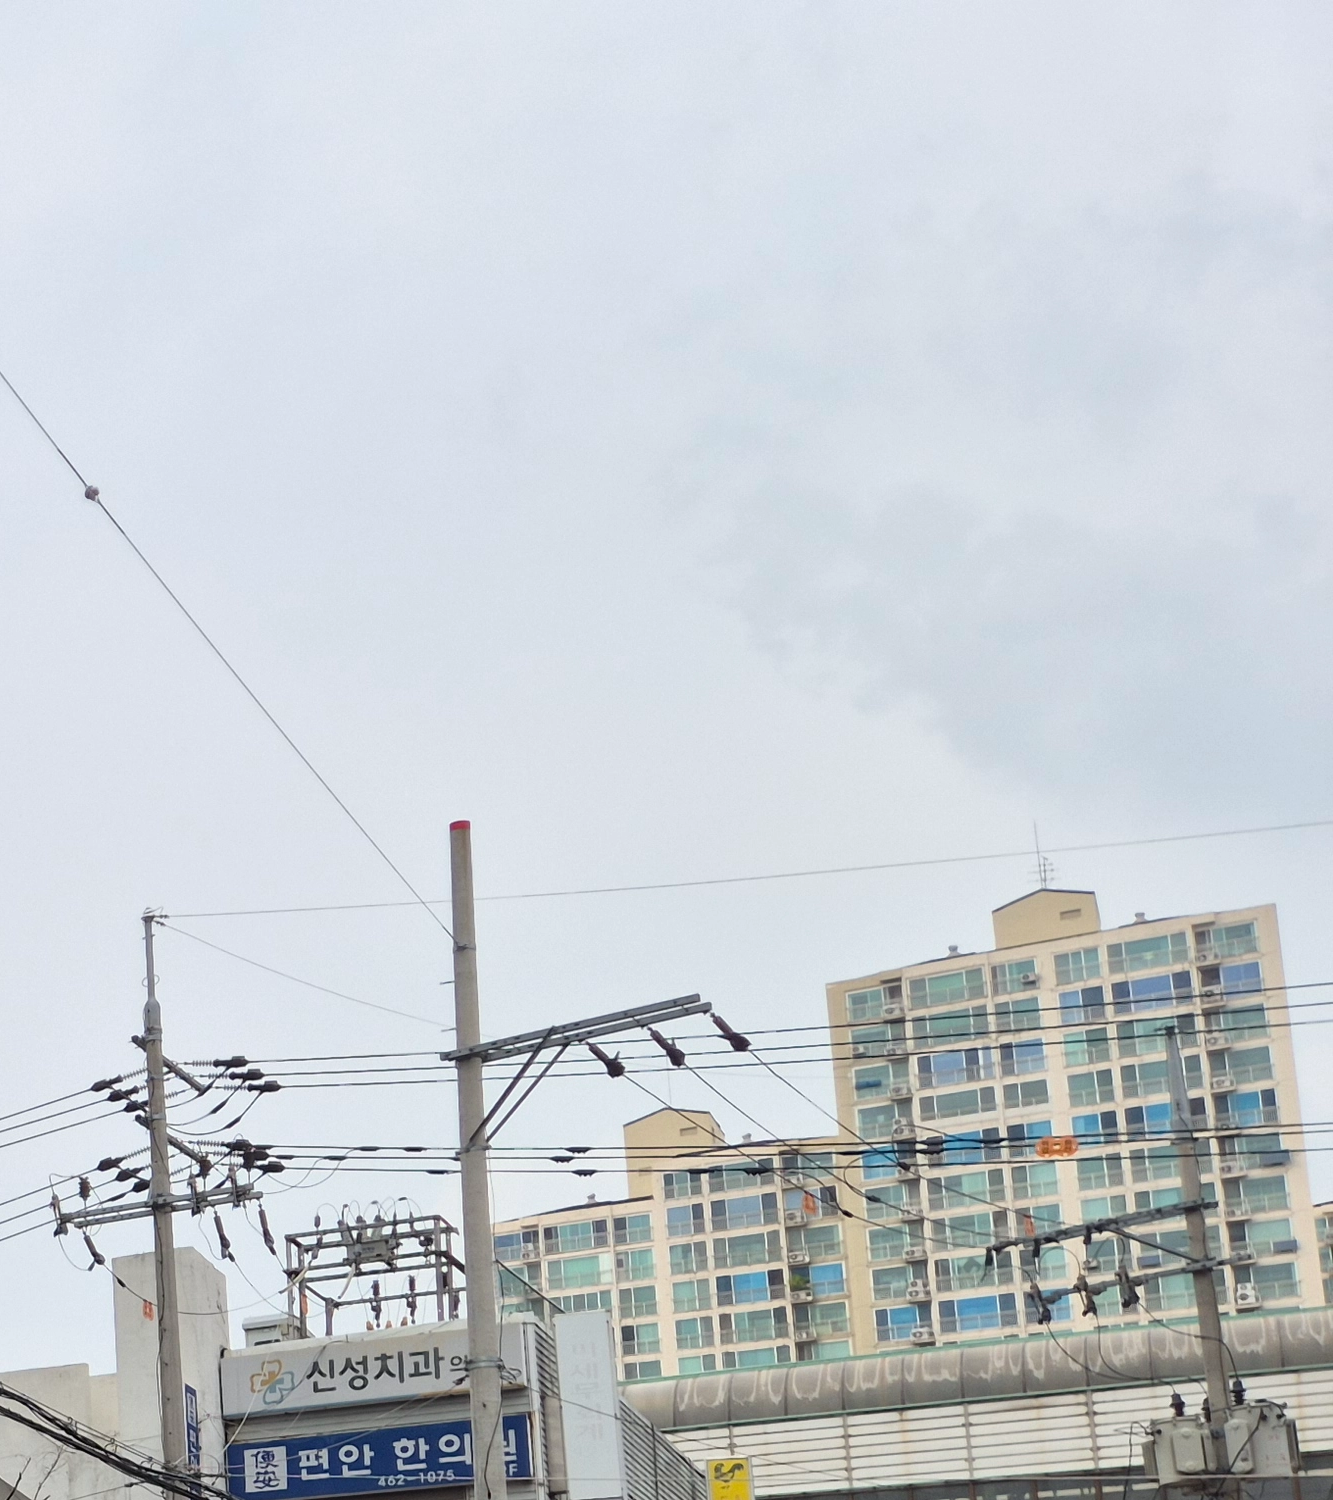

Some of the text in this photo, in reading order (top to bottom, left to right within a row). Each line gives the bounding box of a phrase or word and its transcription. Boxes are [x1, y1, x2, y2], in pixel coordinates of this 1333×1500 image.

[306, 1346, 469, 1394] 신성치과 의
[298, 1443, 375, 1482] 편안
[377, 1469, 456, 1488] 462-1075
